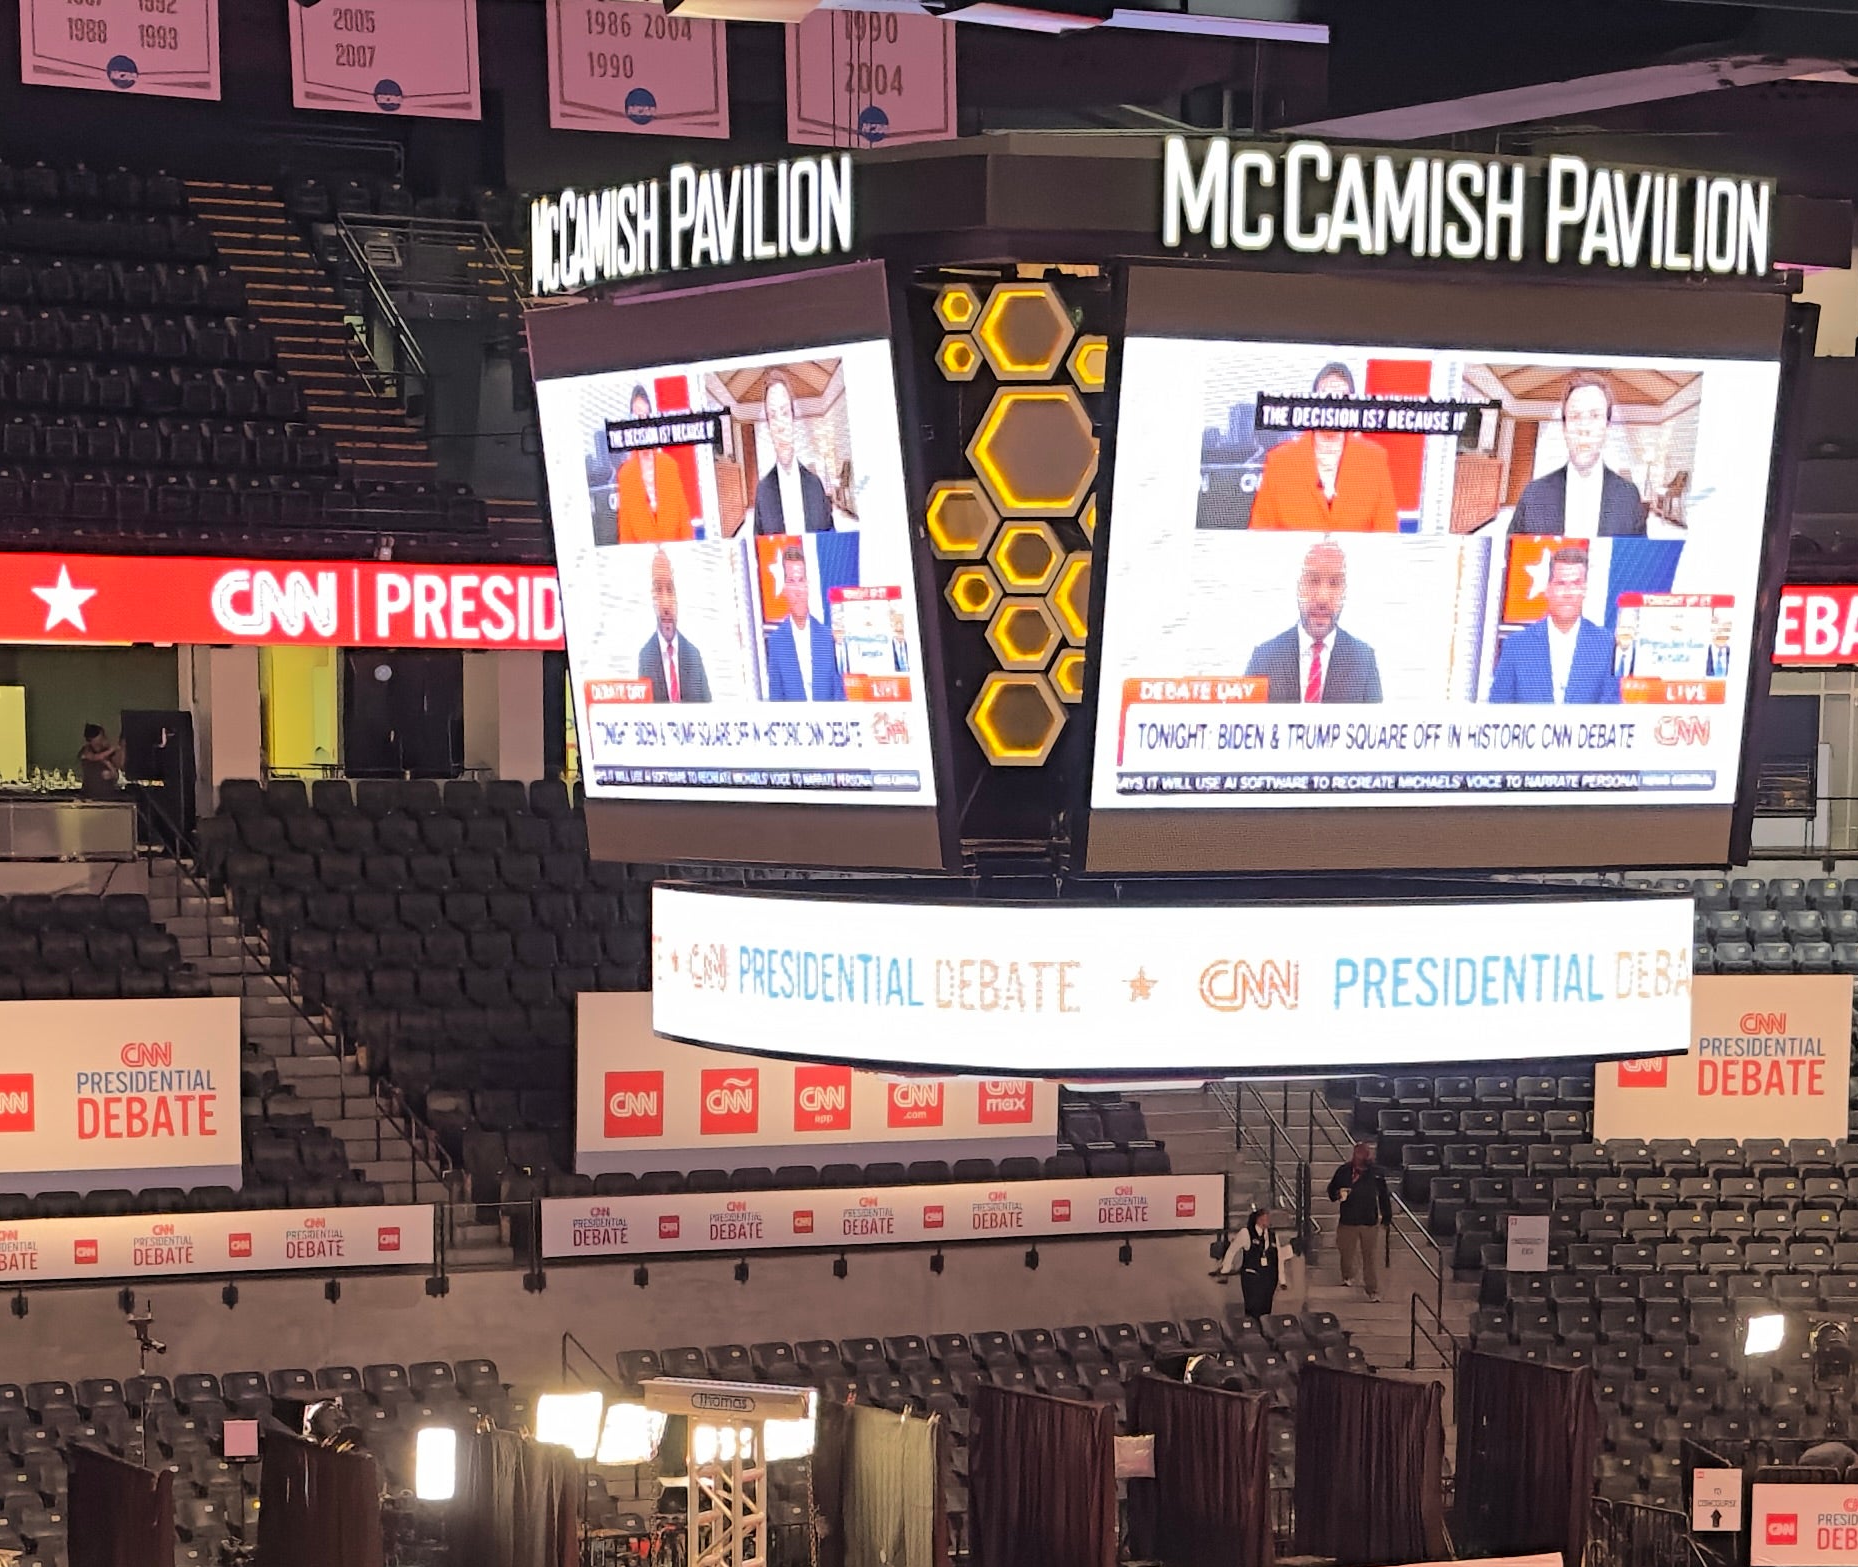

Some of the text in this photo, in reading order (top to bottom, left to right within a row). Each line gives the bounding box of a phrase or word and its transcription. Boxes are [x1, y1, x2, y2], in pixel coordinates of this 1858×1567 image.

[334, 8, 375, 33] 2005
[586, 10, 692, 41] 1986 2004
[844, 11, 898, 44] 1990
[335, 42, 375, 68] 2007
[588, 51, 633, 79] 1990
[844, 62, 903, 97] 2004
[1545, 154, 1771, 276] PAVILION
[1262, 405, 1468, 432] THE DECISION IS? BECAUSE IF
[211, 569, 338, 638] CNN
[1666, 684, 1707, 701] LIVE
[1218, 723, 1264, 750] BIDEN
[1270, 724, 1279, 750] &
[1287, 723, 1340, 750] TRUMP
[1346, 723, 1407, 751] SQUARE
[1413, 723, 1442, 750] OFF
[1447, 724, 1461, 750] IN
[1468, 723, 1536, 750] HISTORIC
[1542, 723, 1572, 750] CNN
[1578, 723, 1636, 750] DEBATE
[1654, 716, 1711, 746] CNN
[1162, 776, 1192, 790] WILL
[1195, 776, 1221, 790] USE
[1240, 776, 1309, 790] SOFTWARE
[1312, 776, 1329, 790] TO
[1332, 776, 1395, 790] RECREATE
[739, 945, 923, 1007] PRESIDENTIAL
[934, 958, 1081, 1014] DEBATE
[1197, 959, 1299, 1013] CNN
[1334, 953, 1604, 1010] PRESIDENTIAL
[1740, 1012, 1786, 1035] CNN
[121, 1042, 171, 1067] CNN
[1698, 1037, 1826, 1058] PRESIDENTIAL
[77, 1069, 217, 1095] PRESIDENTIAL
[1697, 1059, 1825, 1097] DEBATE
[610, 1091, 657, 1117] CNN
[799, 1085, 845, 1111] CNN
[893, 1083, 938, 1108] CNN
[986, 1099, 1026, 1112] max
[77, 1094, 217, 1139] DEBATE
